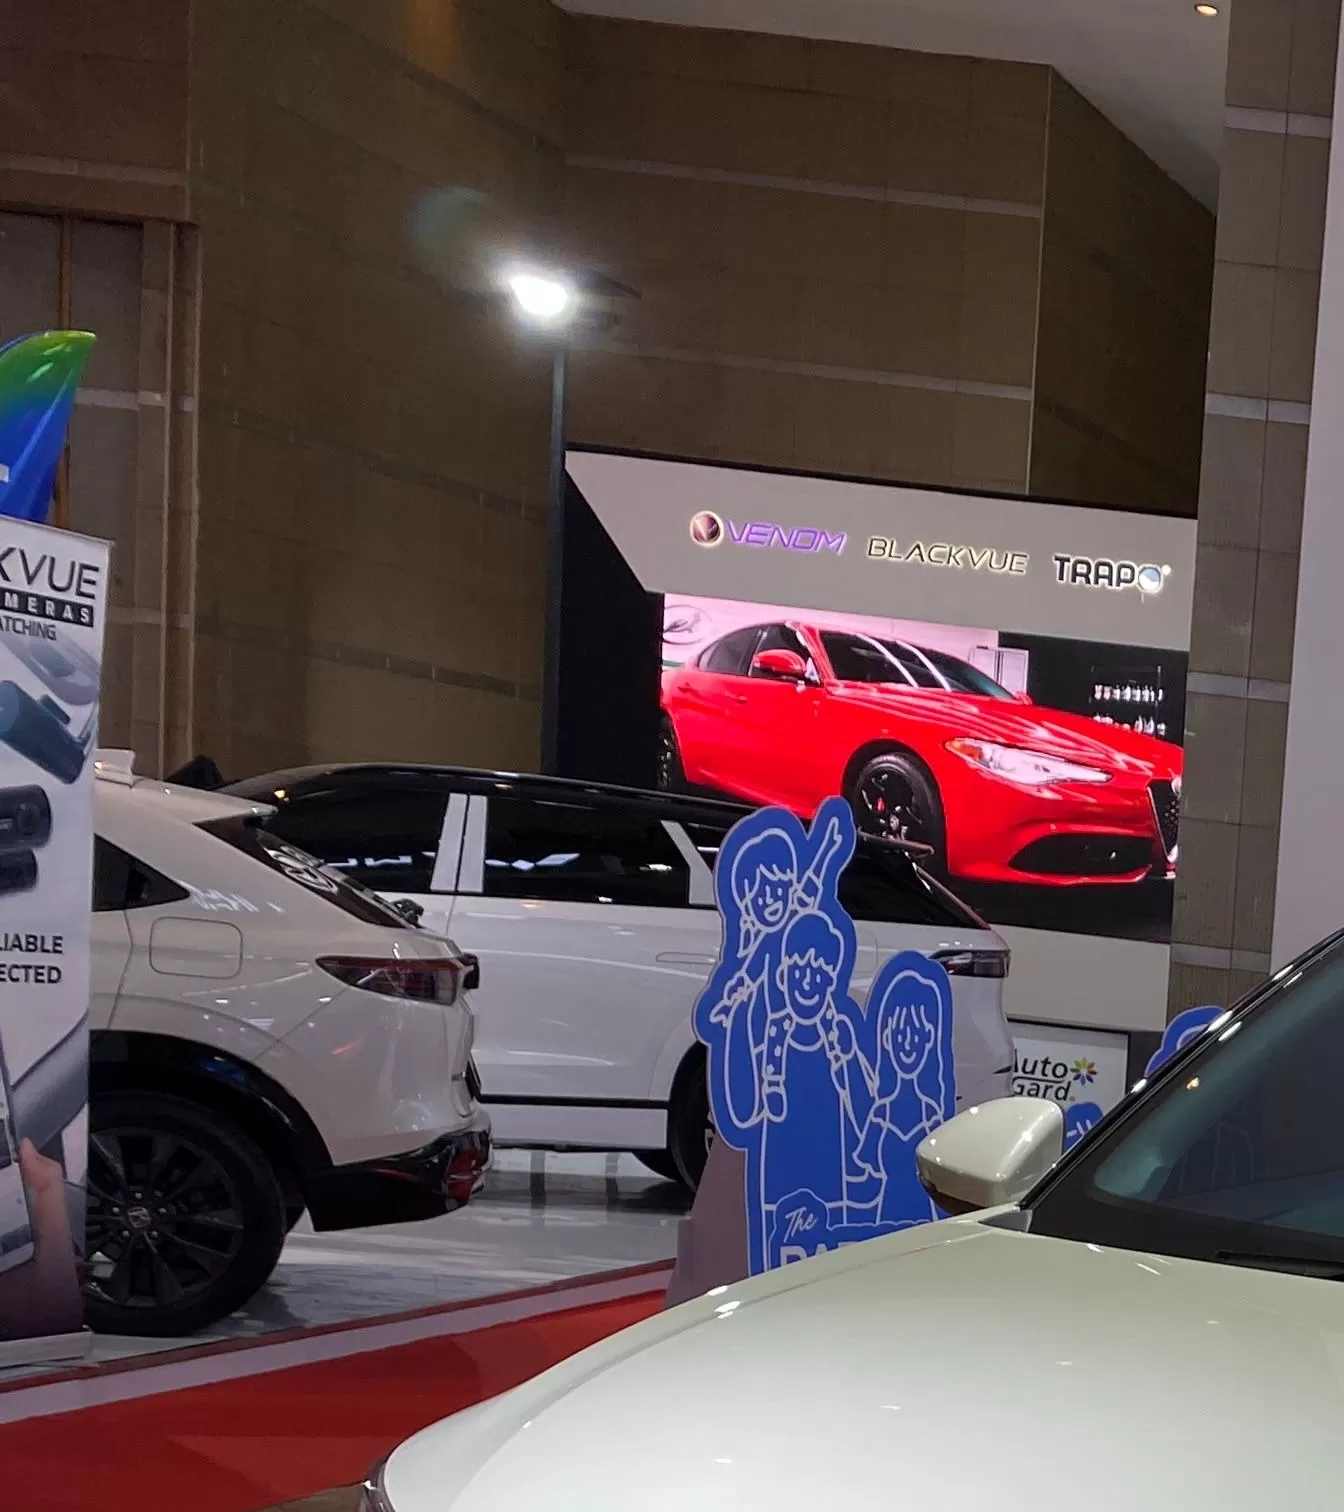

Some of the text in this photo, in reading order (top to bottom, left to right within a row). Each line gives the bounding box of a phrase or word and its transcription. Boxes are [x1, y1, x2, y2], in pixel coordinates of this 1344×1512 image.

[727, 519, 847, 557] VENOM
[866, 536, 1030, 575] BLACKVUE
[784, 1206, 818, 1243] The
